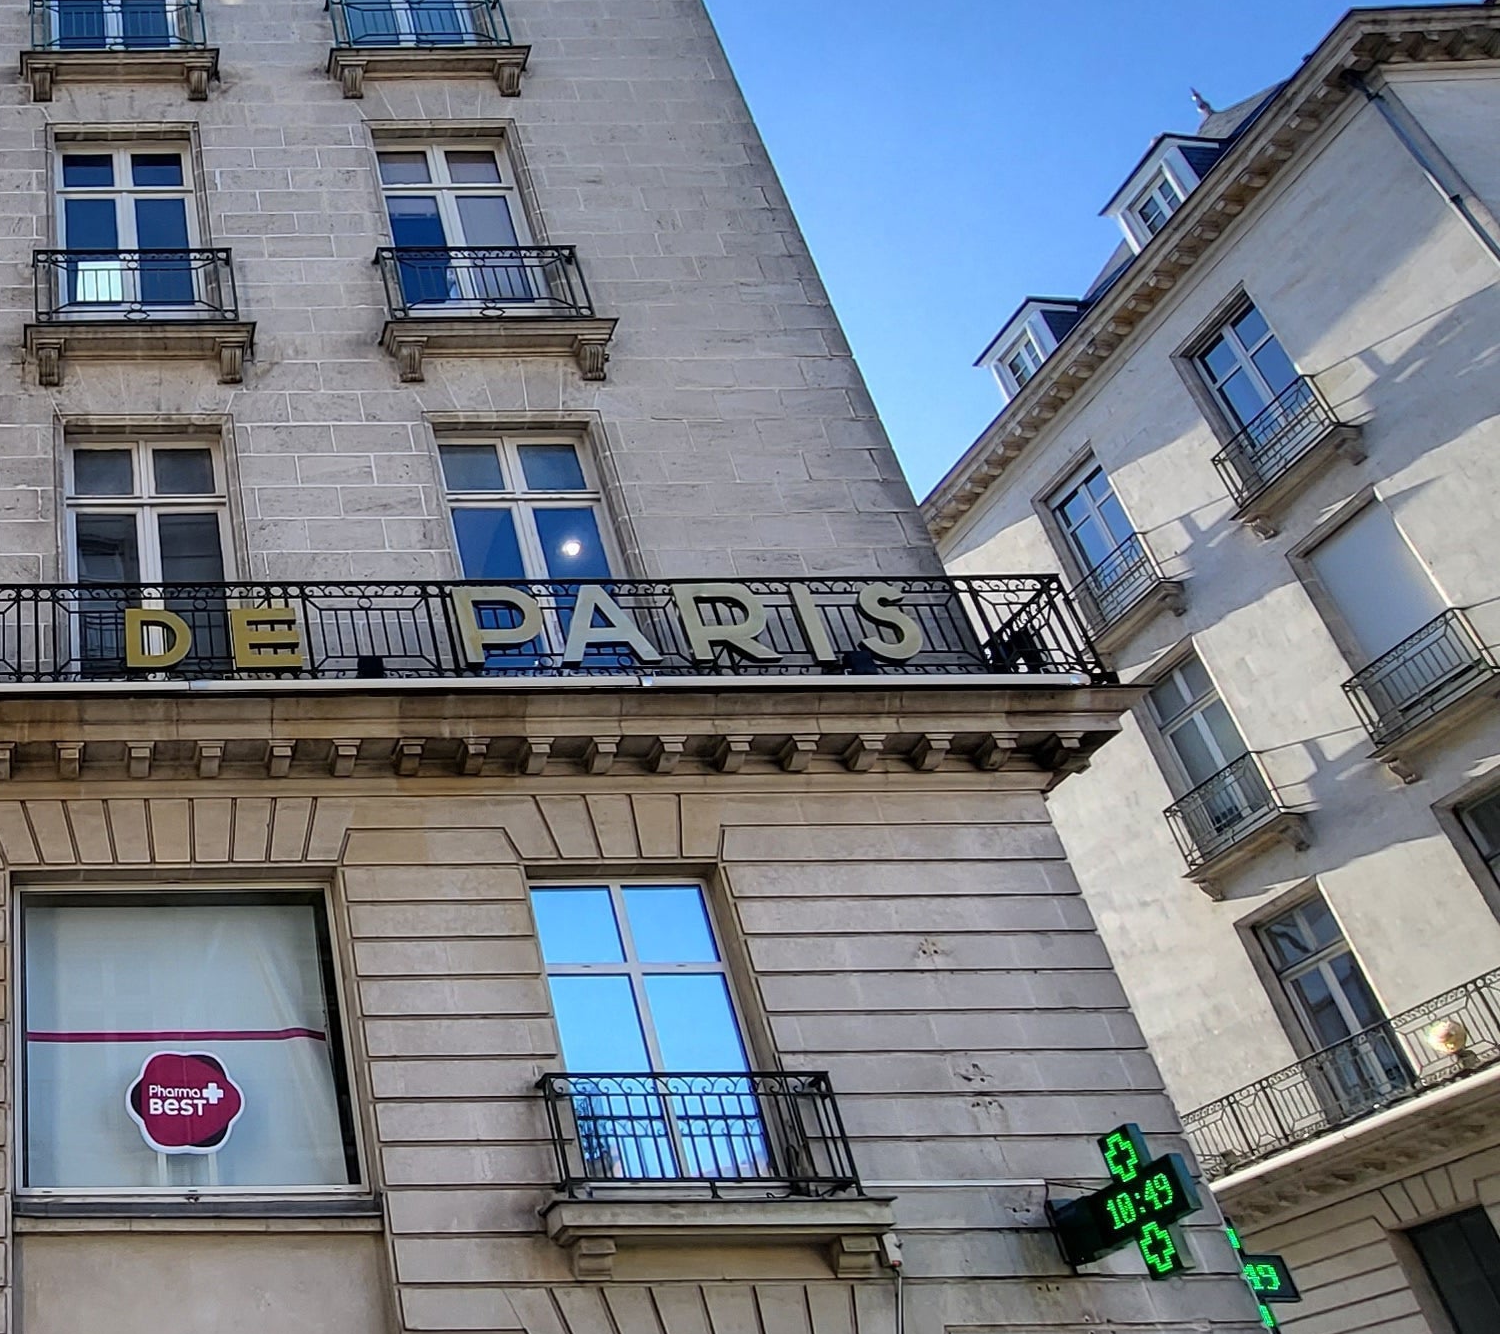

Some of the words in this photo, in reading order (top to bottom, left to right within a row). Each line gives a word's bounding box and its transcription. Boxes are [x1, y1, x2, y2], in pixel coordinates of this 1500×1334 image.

[125, 607, 303, 669] DE
[451, 581, 924, 666] PARIS
[148, 1084, 201, 1098] Pharma
[1106, 1172, 1174, 1230] 10:49
